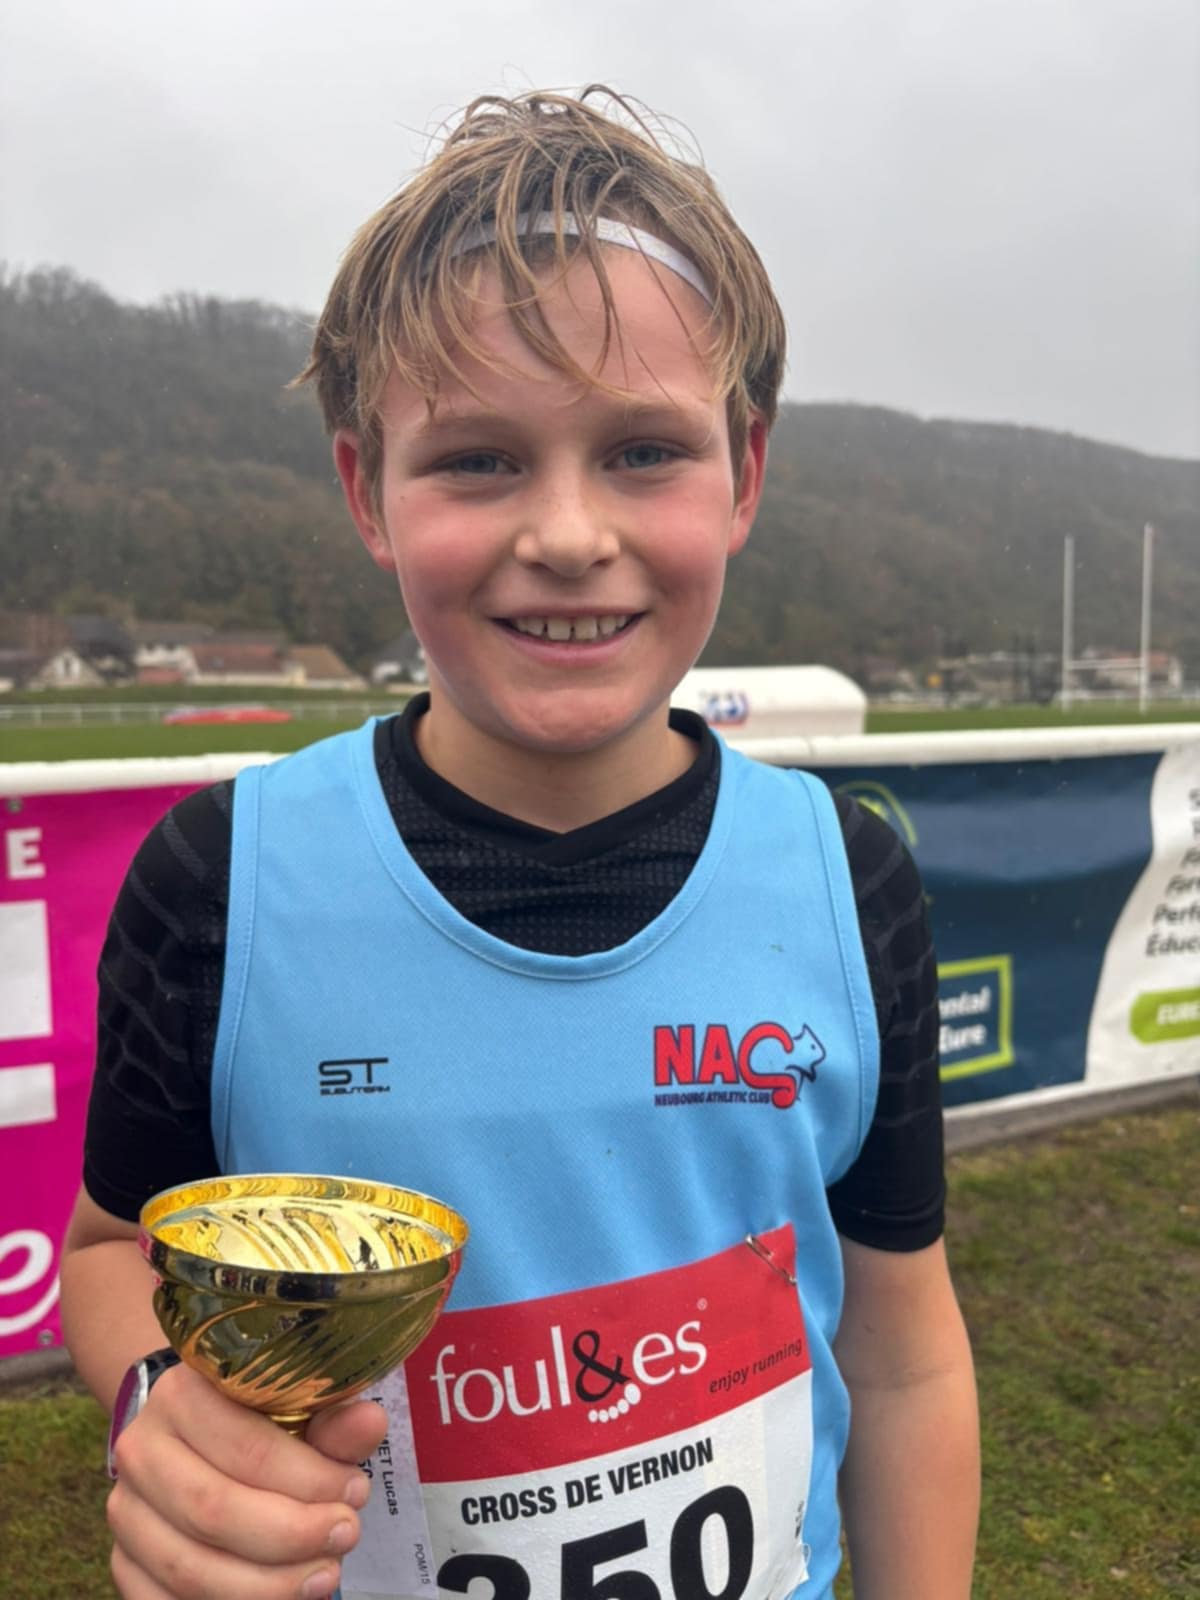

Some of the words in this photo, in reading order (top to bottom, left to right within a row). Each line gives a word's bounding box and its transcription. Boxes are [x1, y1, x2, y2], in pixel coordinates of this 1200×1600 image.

[8, 829, 46, 879] E
[318, 1057, 389, 1086] ST
[654, 1021, 797, 1109] NAC
[748, 1091, 770, 1104] CLUB
[709, 1367, 748, 1393] enjoy
[752, 1339, 802, 1375] running
[382, 1471, 399, 1516] Lucas
[461, 1486, 557, 1525] CROSS
[565, 1474, 602, 1509] DE
[608, 1438, 714, 1495] VERNON
